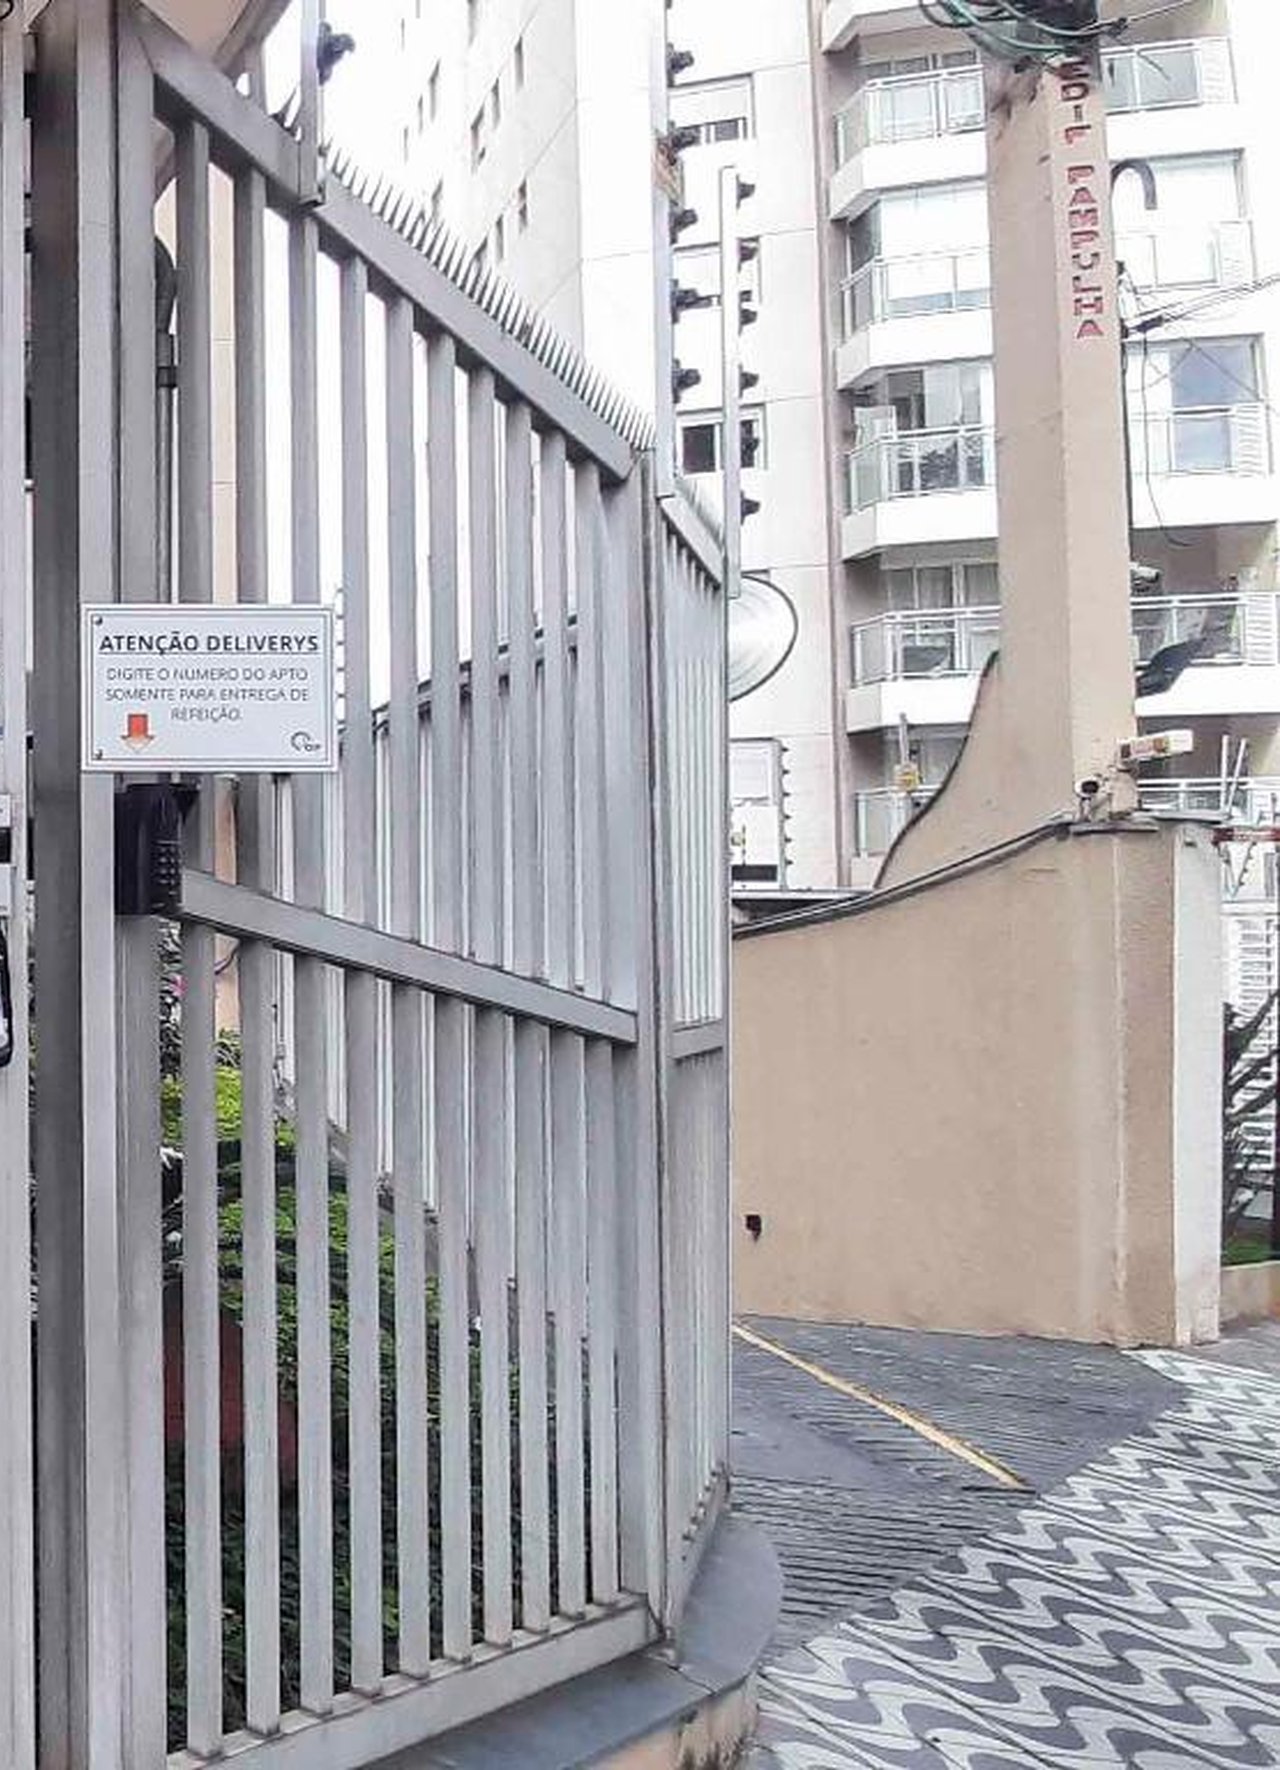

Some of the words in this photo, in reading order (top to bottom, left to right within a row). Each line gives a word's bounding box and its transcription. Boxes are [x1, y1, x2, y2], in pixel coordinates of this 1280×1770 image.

[1068, 166, 1104, 339] PAMPULHA
[100, 631, 199, 654] ATENÇÃO
[207, 635, 319, 651] DELIVERYS
[107, 668, 153, 680] DIGITE
[244, 668, 265, 680] DO
[269, 668, 308, 680] APTO
[105, 688, 175, 701] SOMENTE
[180, 688, 216, 701] PARA
[220, 688, 286, 701] ENTREGA
[291, 688, 308, 701] DE
